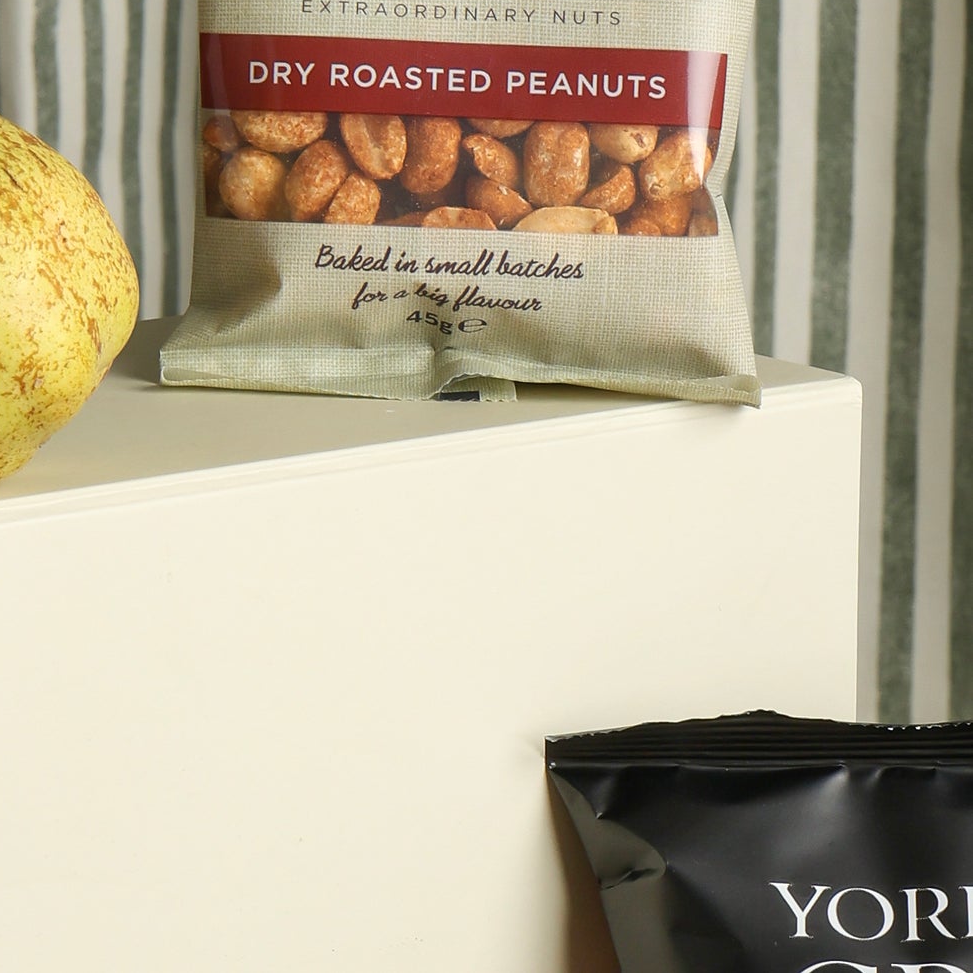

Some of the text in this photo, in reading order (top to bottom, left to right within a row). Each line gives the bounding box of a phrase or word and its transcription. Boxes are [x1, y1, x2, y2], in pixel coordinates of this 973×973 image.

[301, 0, 622, 26] EXTRAORDINARY NUTS
[248, 60, 668, 100] DRY ROASTED PEANUTS
[315, 244, 584, 279] Baked in small batches
[351, 282, 543, 311] for a big flavour
